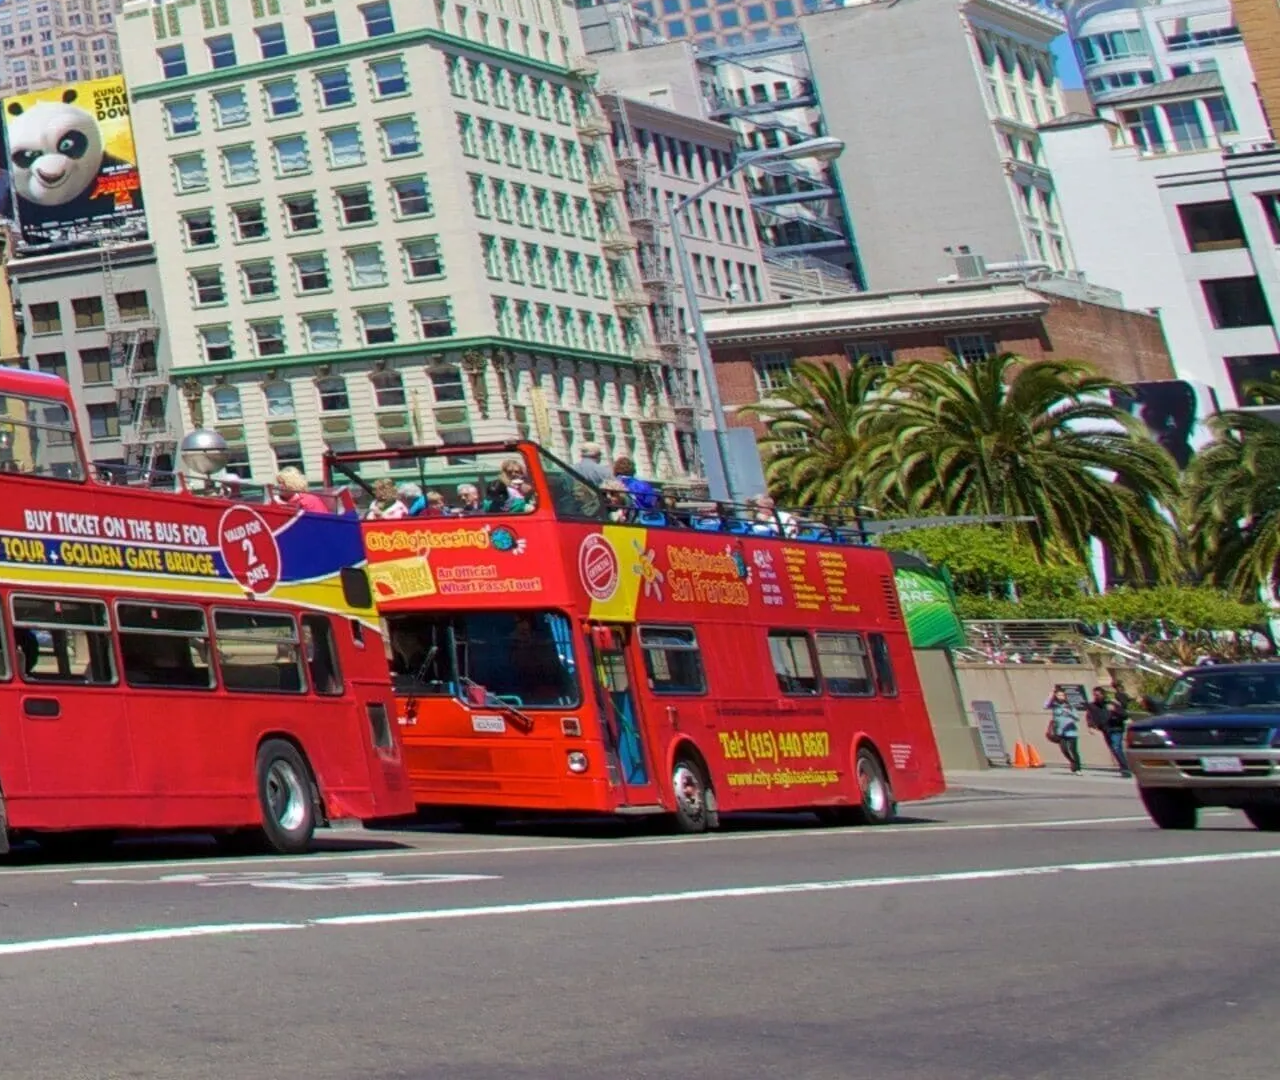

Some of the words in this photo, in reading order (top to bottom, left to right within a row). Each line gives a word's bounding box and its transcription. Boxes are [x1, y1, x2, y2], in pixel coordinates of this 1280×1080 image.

[24, 509, 54, 532] BUY
[55, 512, 101, 537] TICKET
[102, 516, 126, 539] ON
[127, 518, 153, 541] THE
[154, 521, 180, 545] BUS
[183, 525, 209, 546] FOR
[224, 525, 246, 543] VALID
[245, 520, 262, 536] FOR
[1, 537, 45, 563] TOUR
[60, 542, 124, 568] GOLDEN
[124, 548, 163, 572] GATE
[242, 539, 258, 566] 2
[246, 563, 269, 585] DAYS
[438, 566, 453, 579] An
[666, 568, 695, 602] San
[691, 571, 750, 606] Francisco
[718, 731, 745, 758] Tel:
[745, 730, 778, 764] (415)
[779, 733, 800, 758] 440
